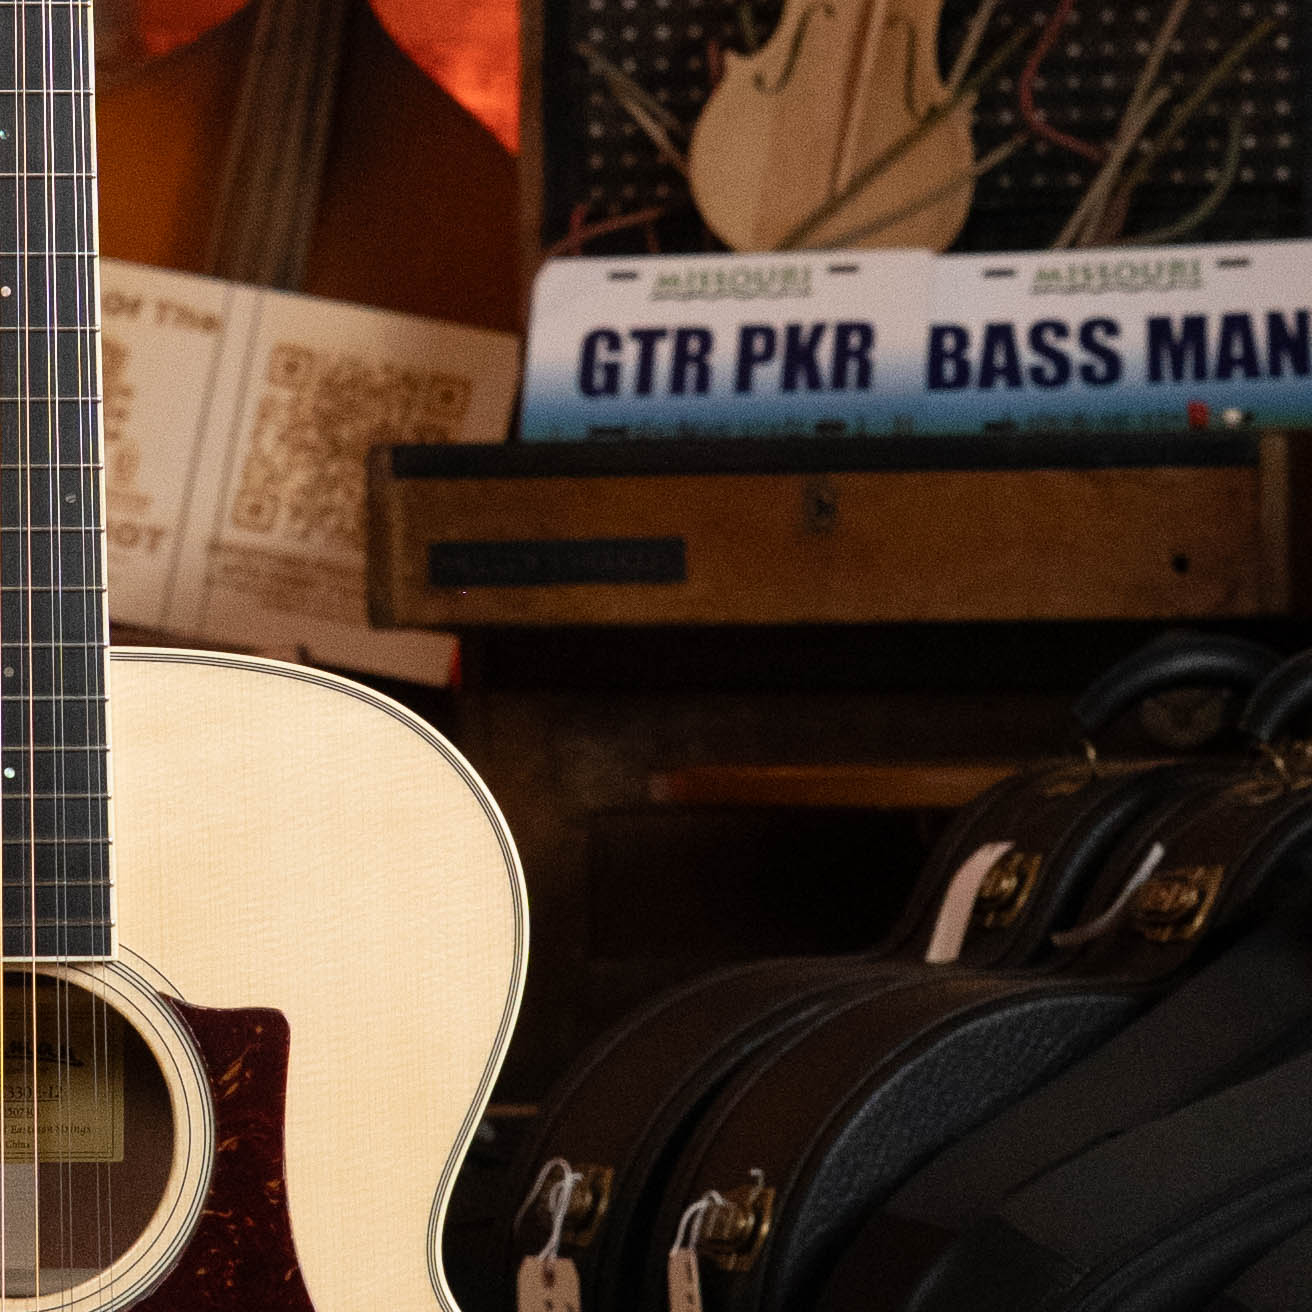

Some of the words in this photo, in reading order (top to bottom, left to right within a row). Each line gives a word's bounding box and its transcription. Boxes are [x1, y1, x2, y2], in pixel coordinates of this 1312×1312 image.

[577, 325, 714, 397] GTR
[733, 320, 876, 395] PKR
[925, 317, 1124, 391] BASS
[1146, 308, 1312, 383] MAN
